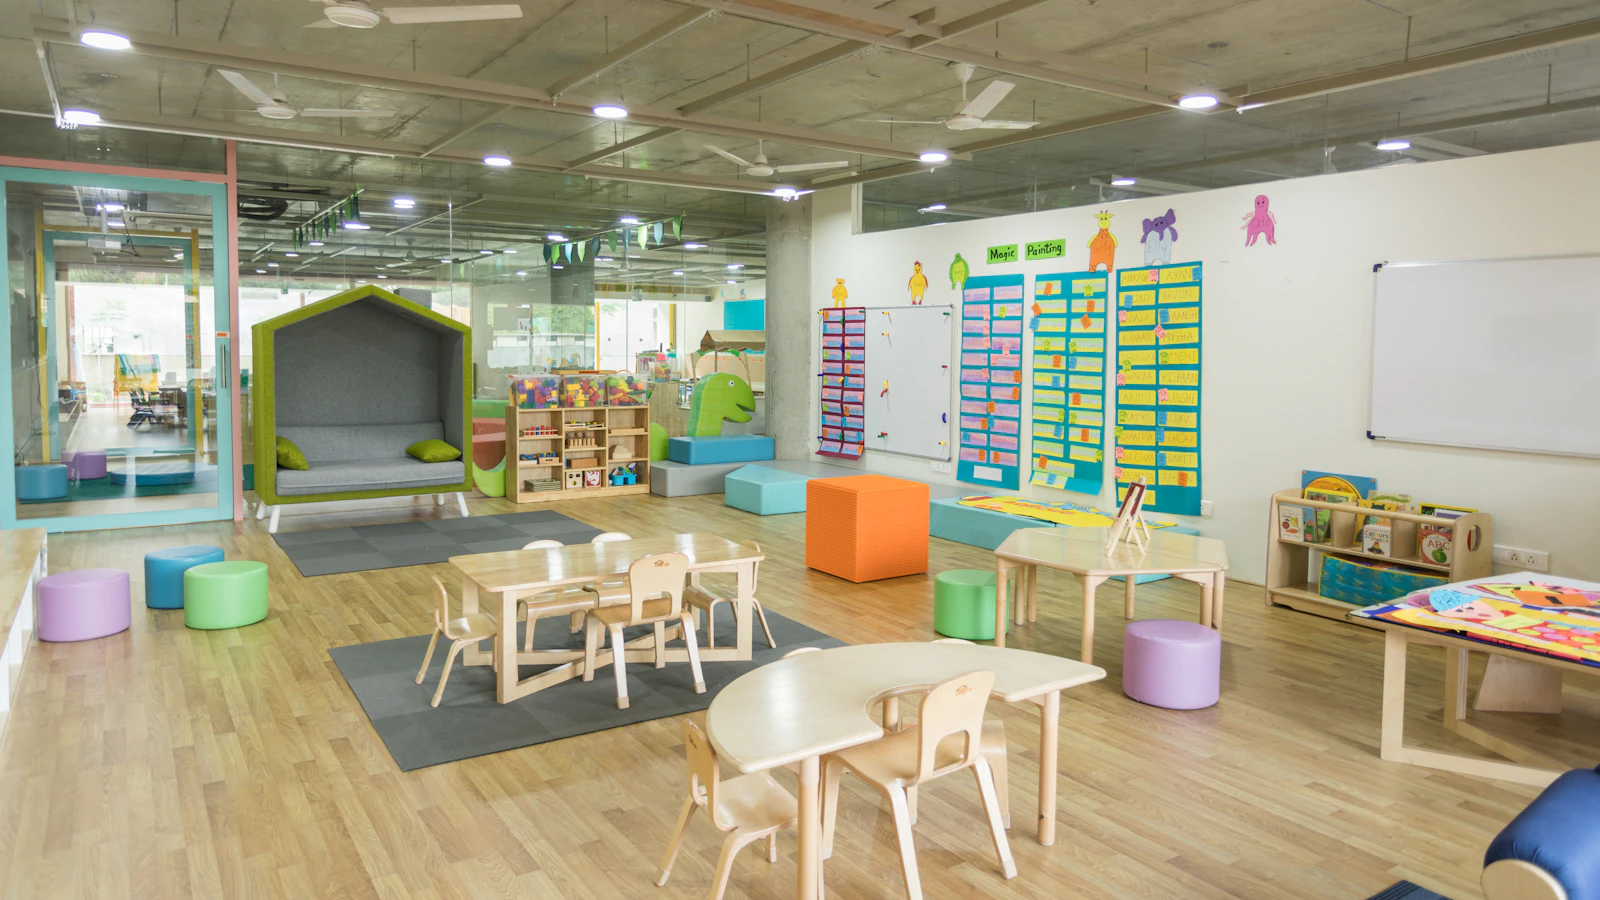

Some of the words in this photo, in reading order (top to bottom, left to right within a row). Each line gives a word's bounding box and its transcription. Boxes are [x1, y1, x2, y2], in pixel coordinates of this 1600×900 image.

[990, 246, 1015, 261] Magic
[1027, 243, 1062, 256] Painting
[1147, 239, 1168, 260] Elly
[1165, 268, 1192, 281] AYAN
[1161, 289, 1192, 302] ARJUN
[1162, 331, 1194, 343] MYSHA
[1168, 349, 1198, 362] ANSHI
[1364, 530, 1389, 539] Colours
[1427, 539, 1451, 551] ABC
